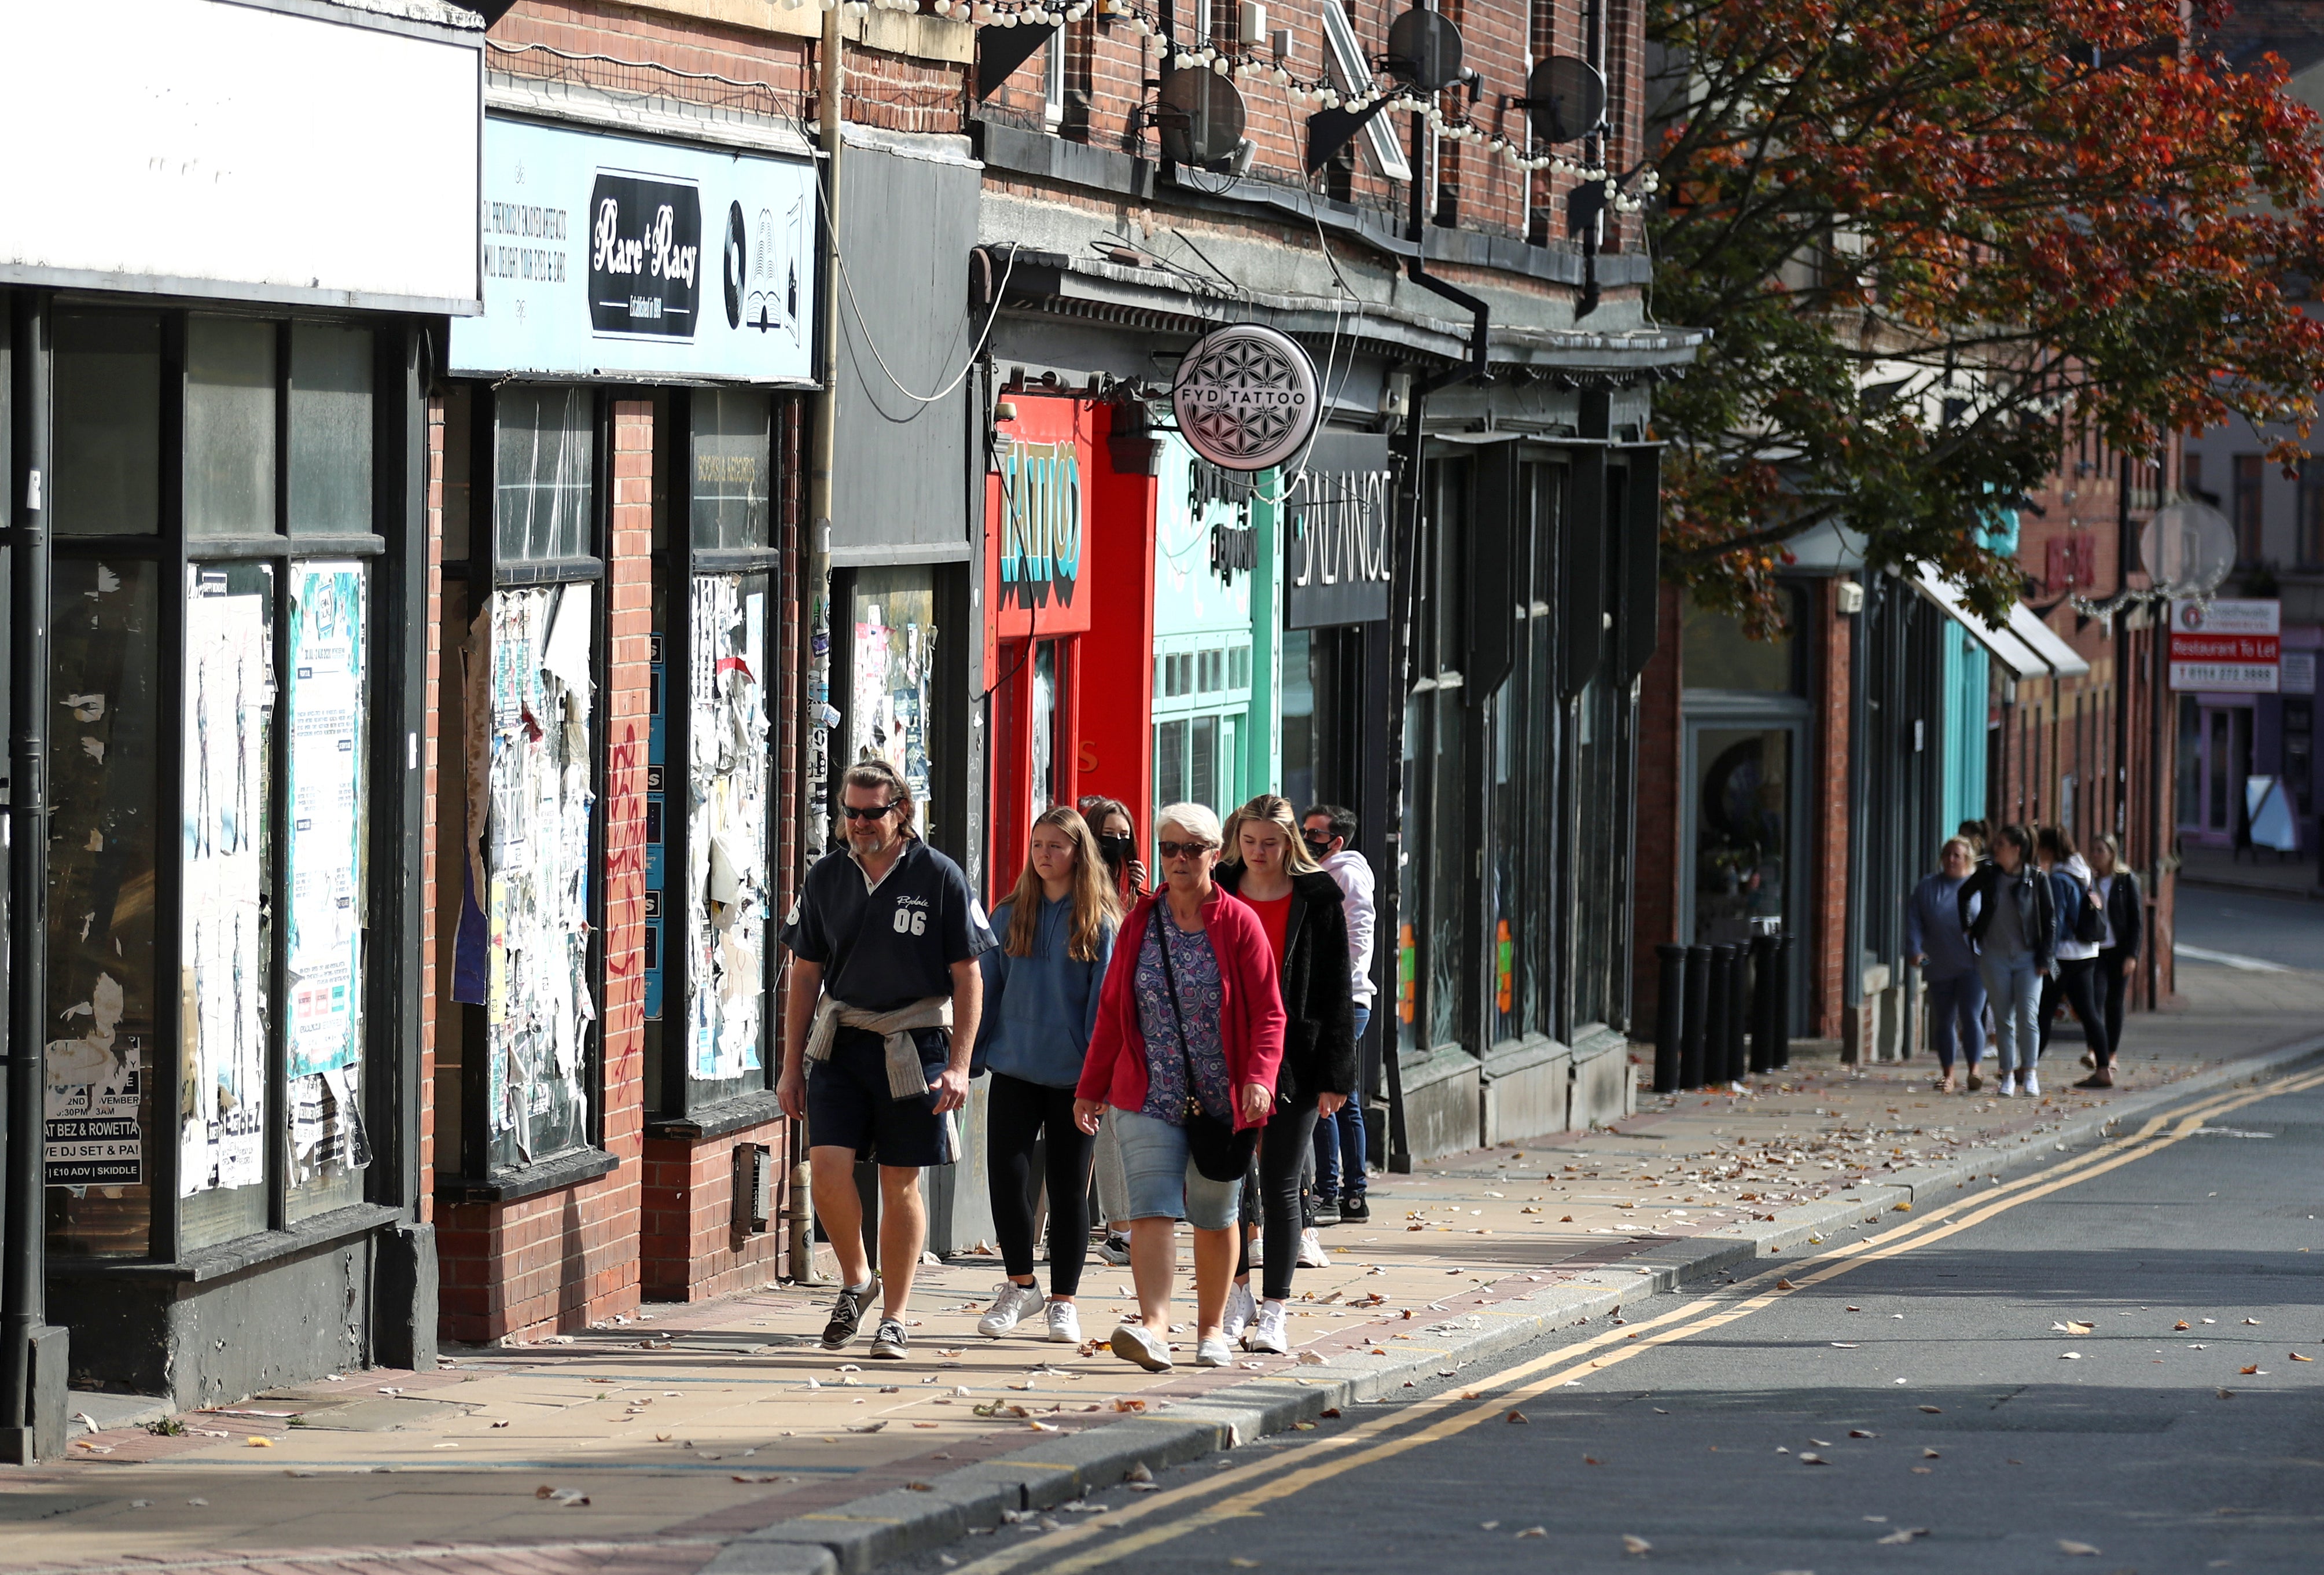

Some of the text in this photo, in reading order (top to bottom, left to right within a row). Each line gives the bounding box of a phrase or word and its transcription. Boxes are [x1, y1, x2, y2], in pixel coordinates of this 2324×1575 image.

[493, 201, 520, 237] PREVIOUSLY
[522, 205, 542, 238] ENJOYED
[543, 207, 566, 241] ARTEFACTS
[594, 198, 643, 275] Rare
[651, 205, 697, 289] Racy
[484, 244, 566, 283] WILL DELIGHT YOUR EYES & EARS
[630, 295, 649, 318] Established
[649, 297, 653, 318] in
[1182, 388, 1306, 405] FYD TATTOO
[1001, 439, 1082, 582] TATTOO
[1297, 470, 1391, 586] BALANCE
[2172, 637, 2276, 658] Restaurant To Let
[2188, 666, 2216, 680] 0114
[893, 908, 926, 936] 06
[100, 1096, 139, 1104] VEMBER
[57, 1123, 78, 1136] BEZ
[79, 1123, 87, 1136] &
[89, 1121, 138, 1136] ROWETTA
[61, 1146, 76, 1157] DJ
[80, 1146, 104, 1156] SET
[106, 1145, 115, 1155] &
[119, 1144, 138, 1155] PA!
[53, 1168, 69, 1177] £10
[71, 1167, 90, 1176] ADV
[97, 1166, 137, 1175] SKIDDLE
